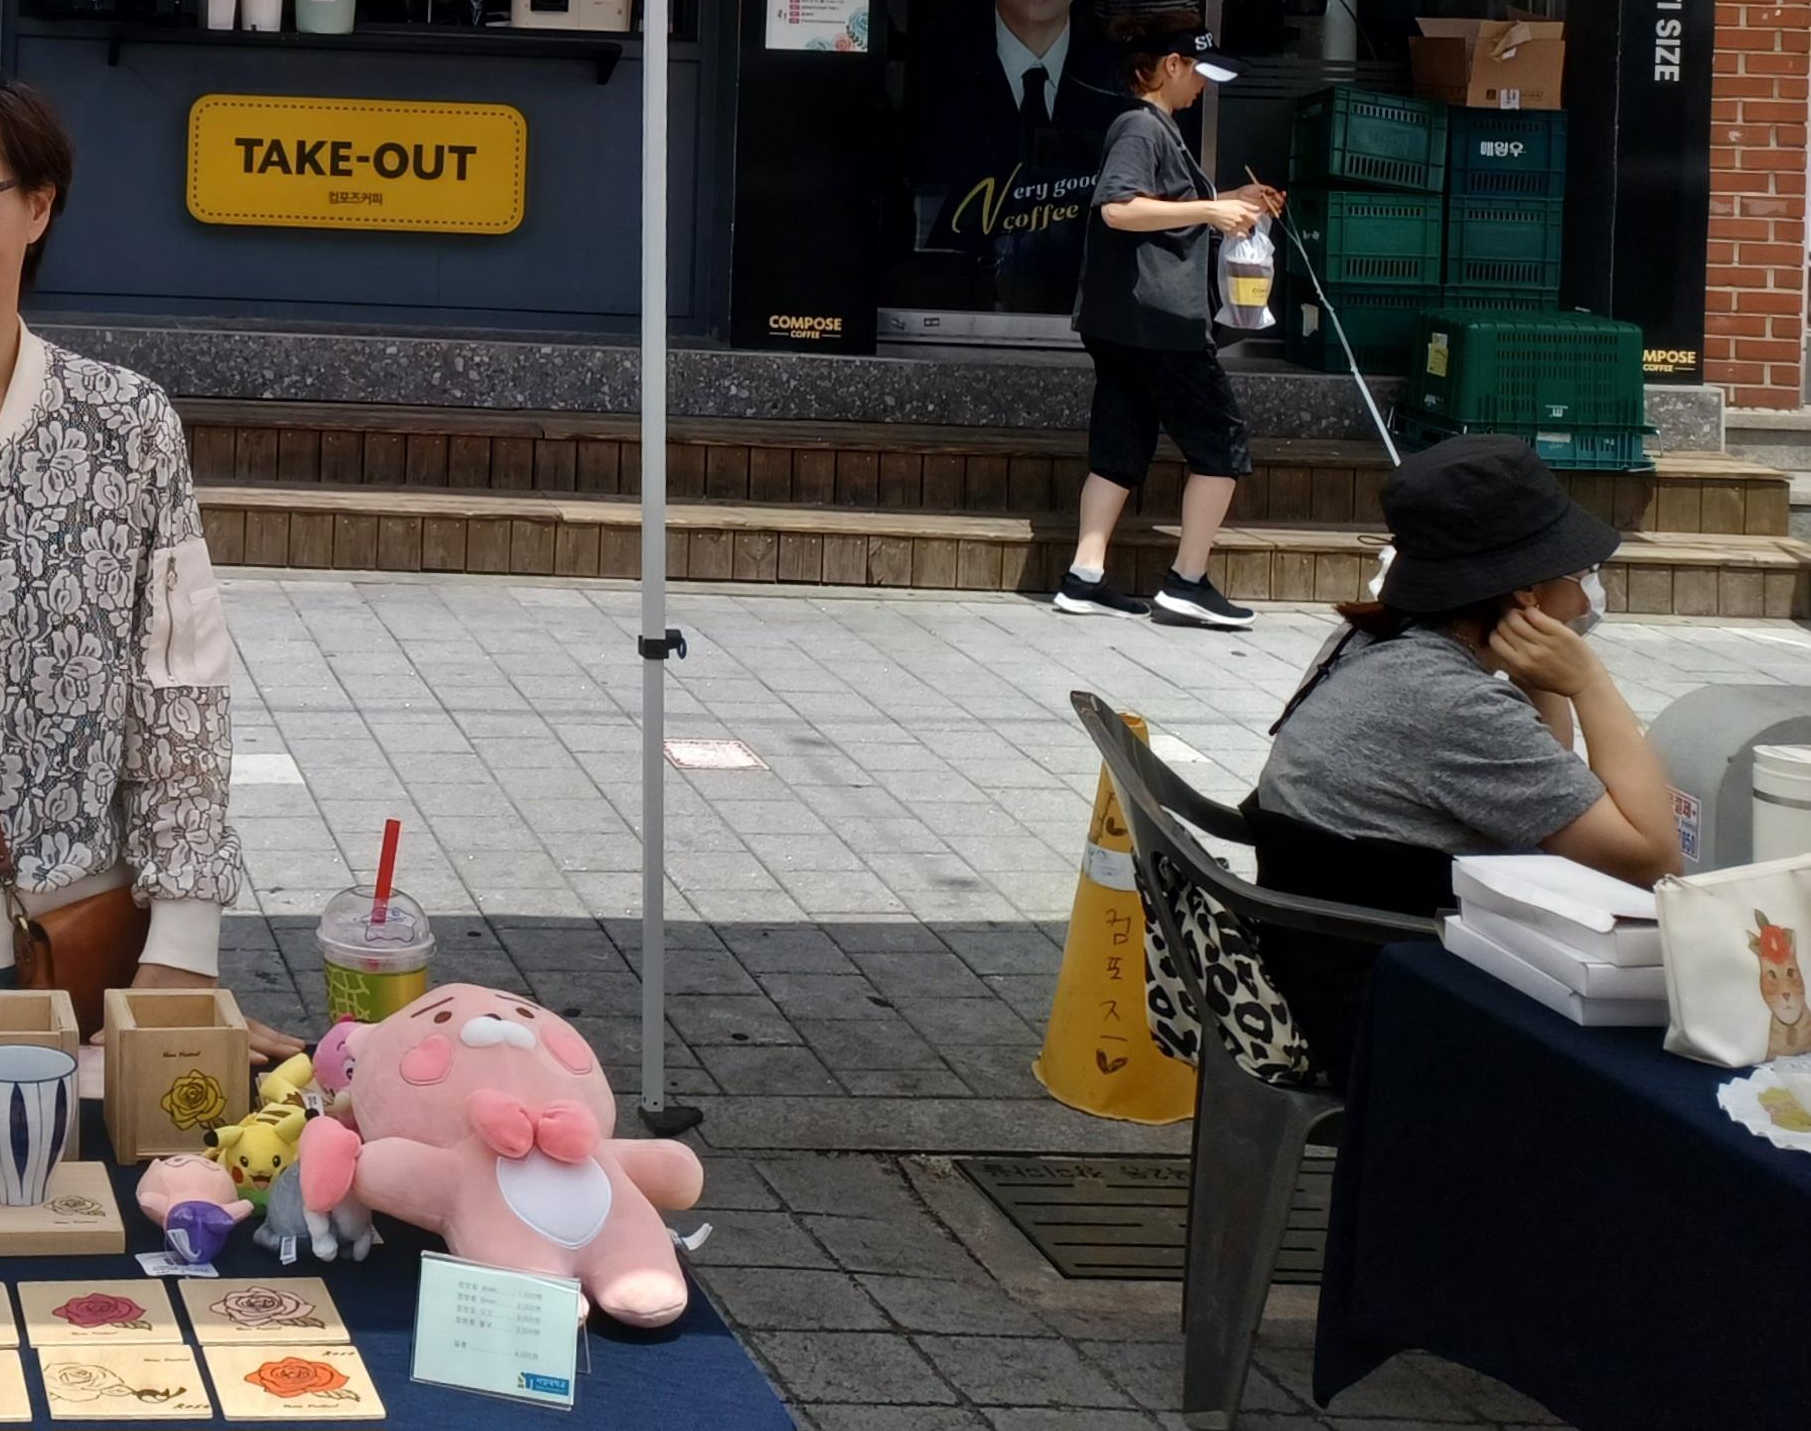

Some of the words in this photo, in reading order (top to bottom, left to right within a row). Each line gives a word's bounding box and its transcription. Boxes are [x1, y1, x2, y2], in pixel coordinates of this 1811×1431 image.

[1654, 19, 1682, 82] SIZE
[235, 137, 477, 181] TAKE-OUT
[329, 190, 383, 206] 컴포즈커피
[1003, 203, 1079, 234] coffee
[769, 315, 842, 331] COMPOSE
[790, 329, 820, 339] COFFEE
[1642, 349, 1696, 364] MPOSE
